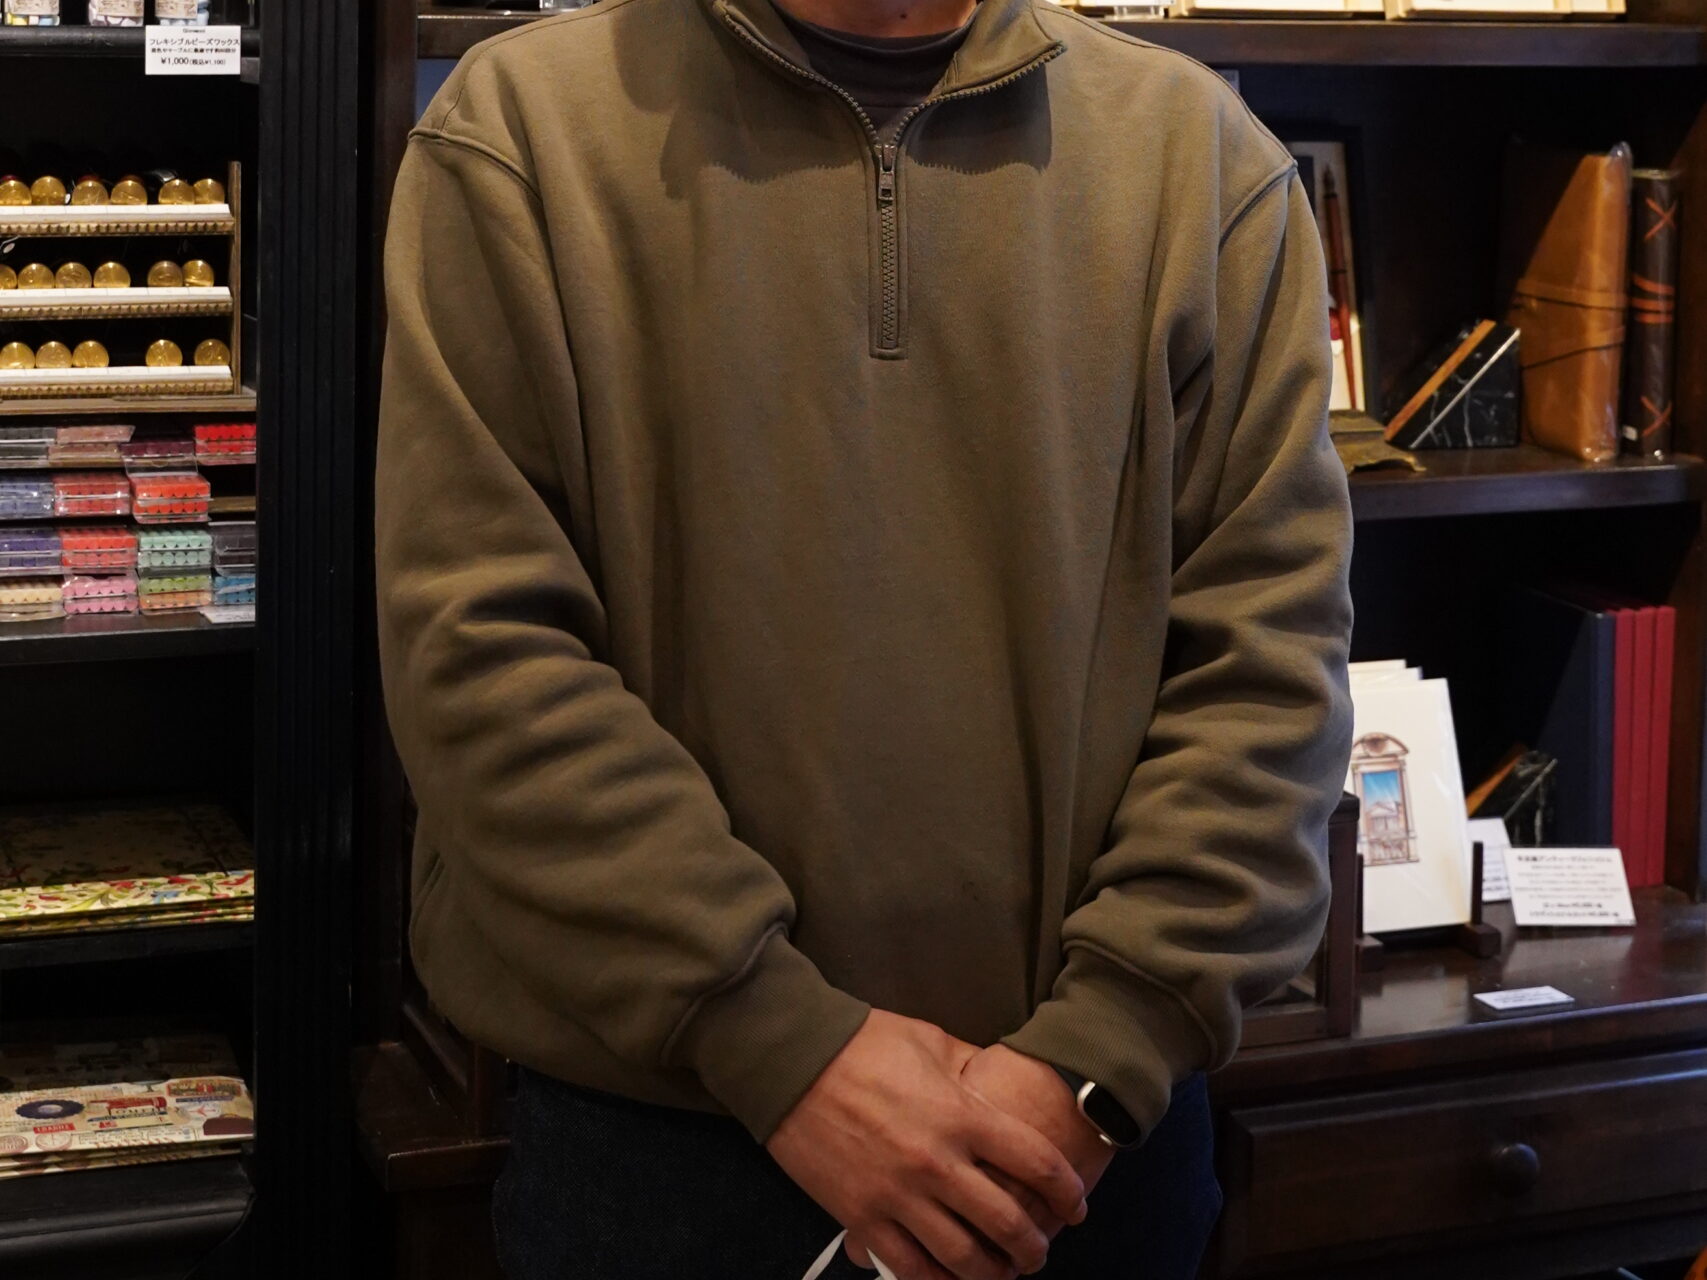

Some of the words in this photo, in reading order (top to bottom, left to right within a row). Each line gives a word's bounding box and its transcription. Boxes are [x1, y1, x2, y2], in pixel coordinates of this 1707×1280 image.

[150, 38, 240, 46] フレキシブルビーズワックス
